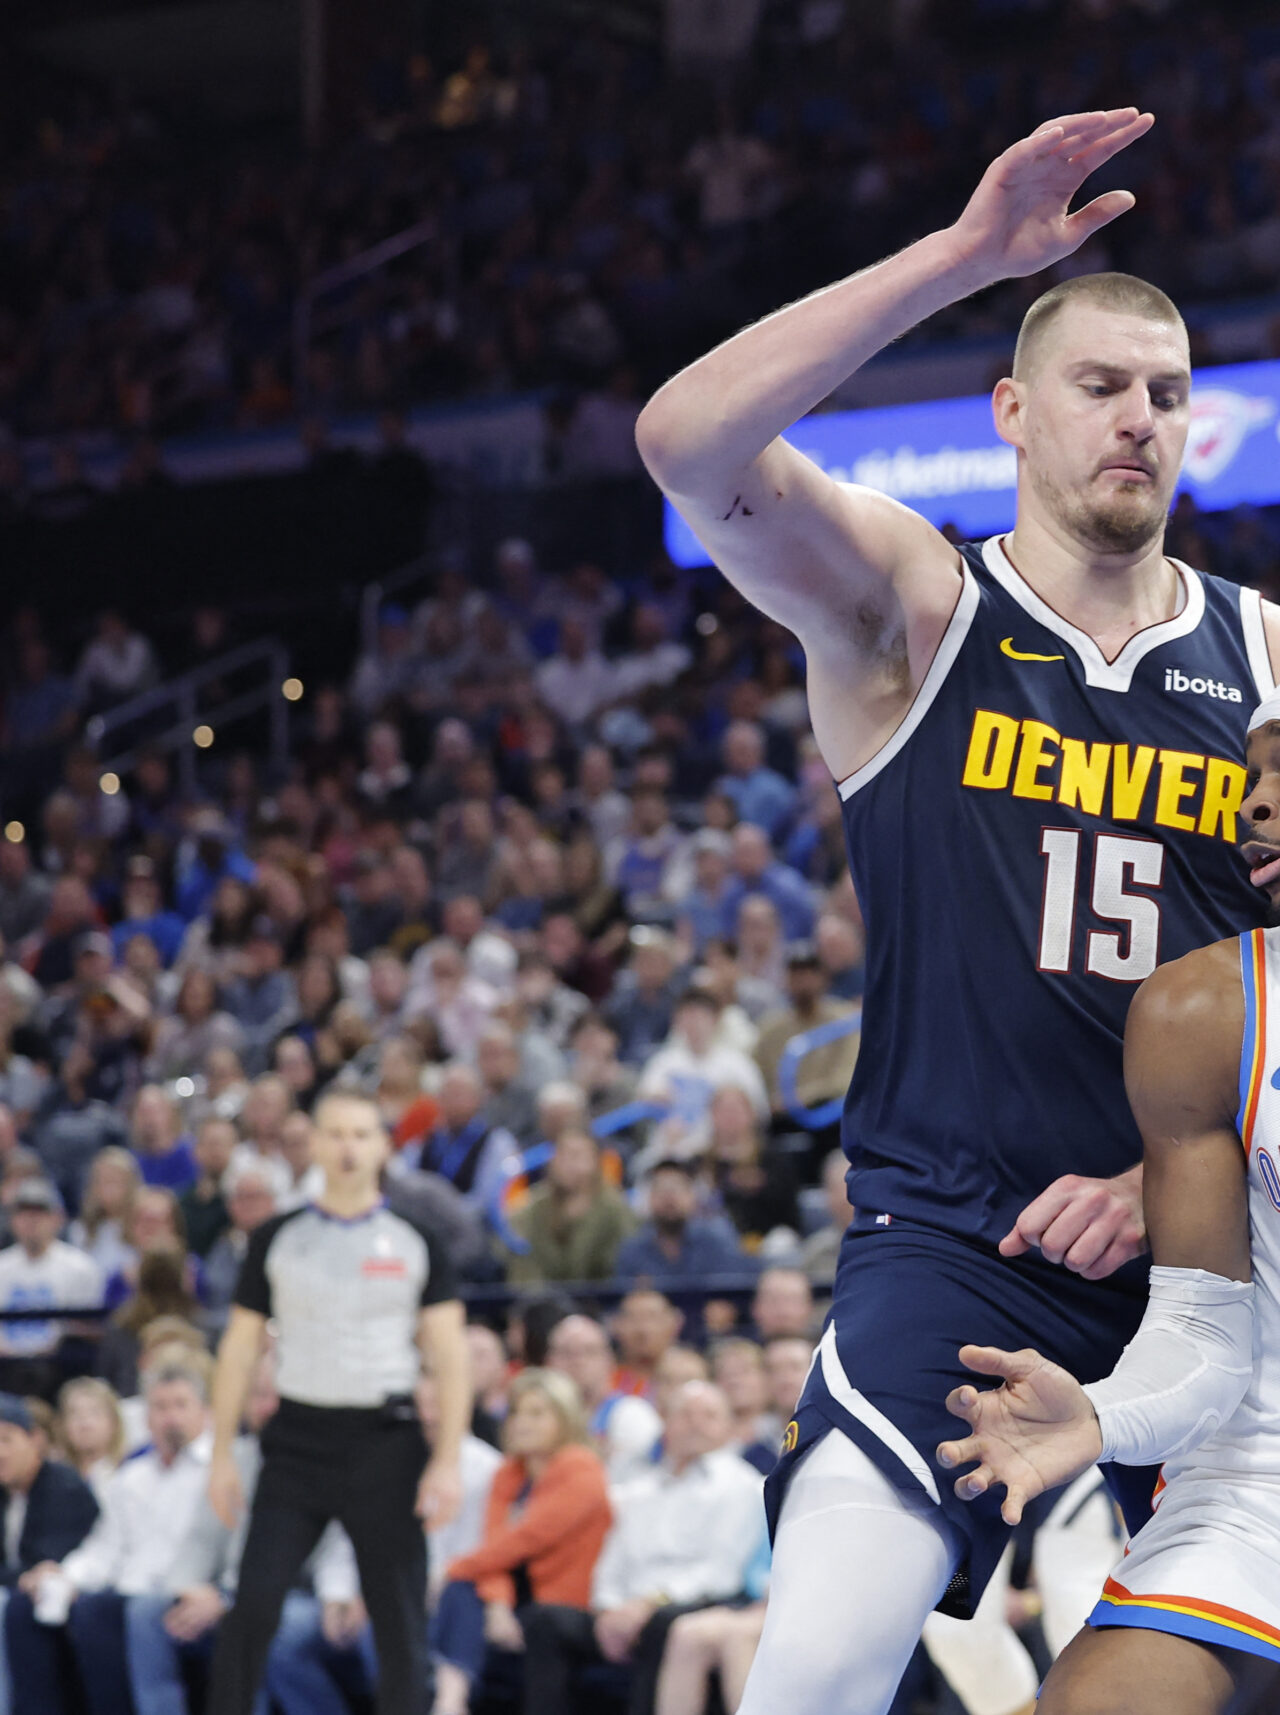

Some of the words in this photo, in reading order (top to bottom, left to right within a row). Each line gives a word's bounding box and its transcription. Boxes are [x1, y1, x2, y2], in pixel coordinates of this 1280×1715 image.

[1165, 668, 1243, 703] ibotta
[962, 707, 1248, 844] DENVER
[1036, 825, 1165, 983] 15
